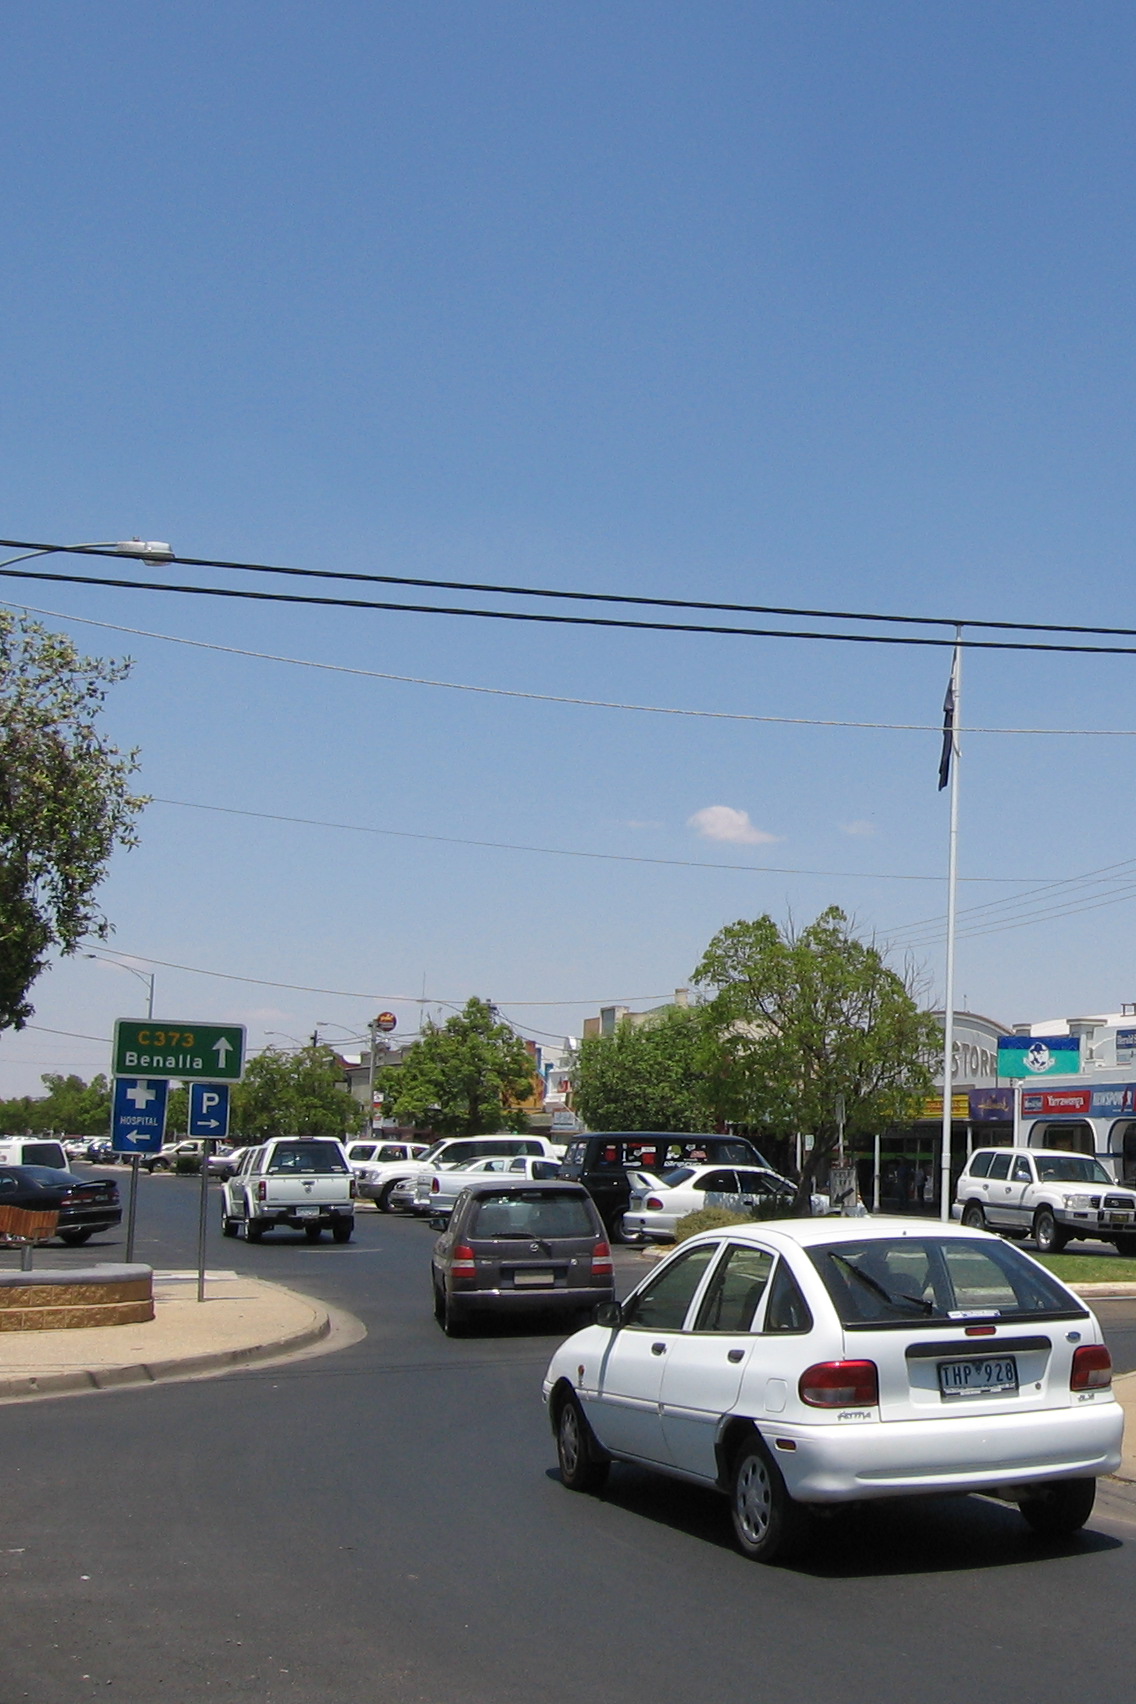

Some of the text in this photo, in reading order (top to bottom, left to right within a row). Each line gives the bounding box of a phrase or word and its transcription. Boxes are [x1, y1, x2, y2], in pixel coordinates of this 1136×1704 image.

[138, 1031, 195, 1048] C373
[125, 1051, 203, 1069] Benalla
[202, 1093, 220, 1114] P
[1047, 1096, 1084, 1109] Yarrawonga
[120, 1116, 158, 1126] HOSPITAL
[943, 1362, 1013, 1386] THP 928
